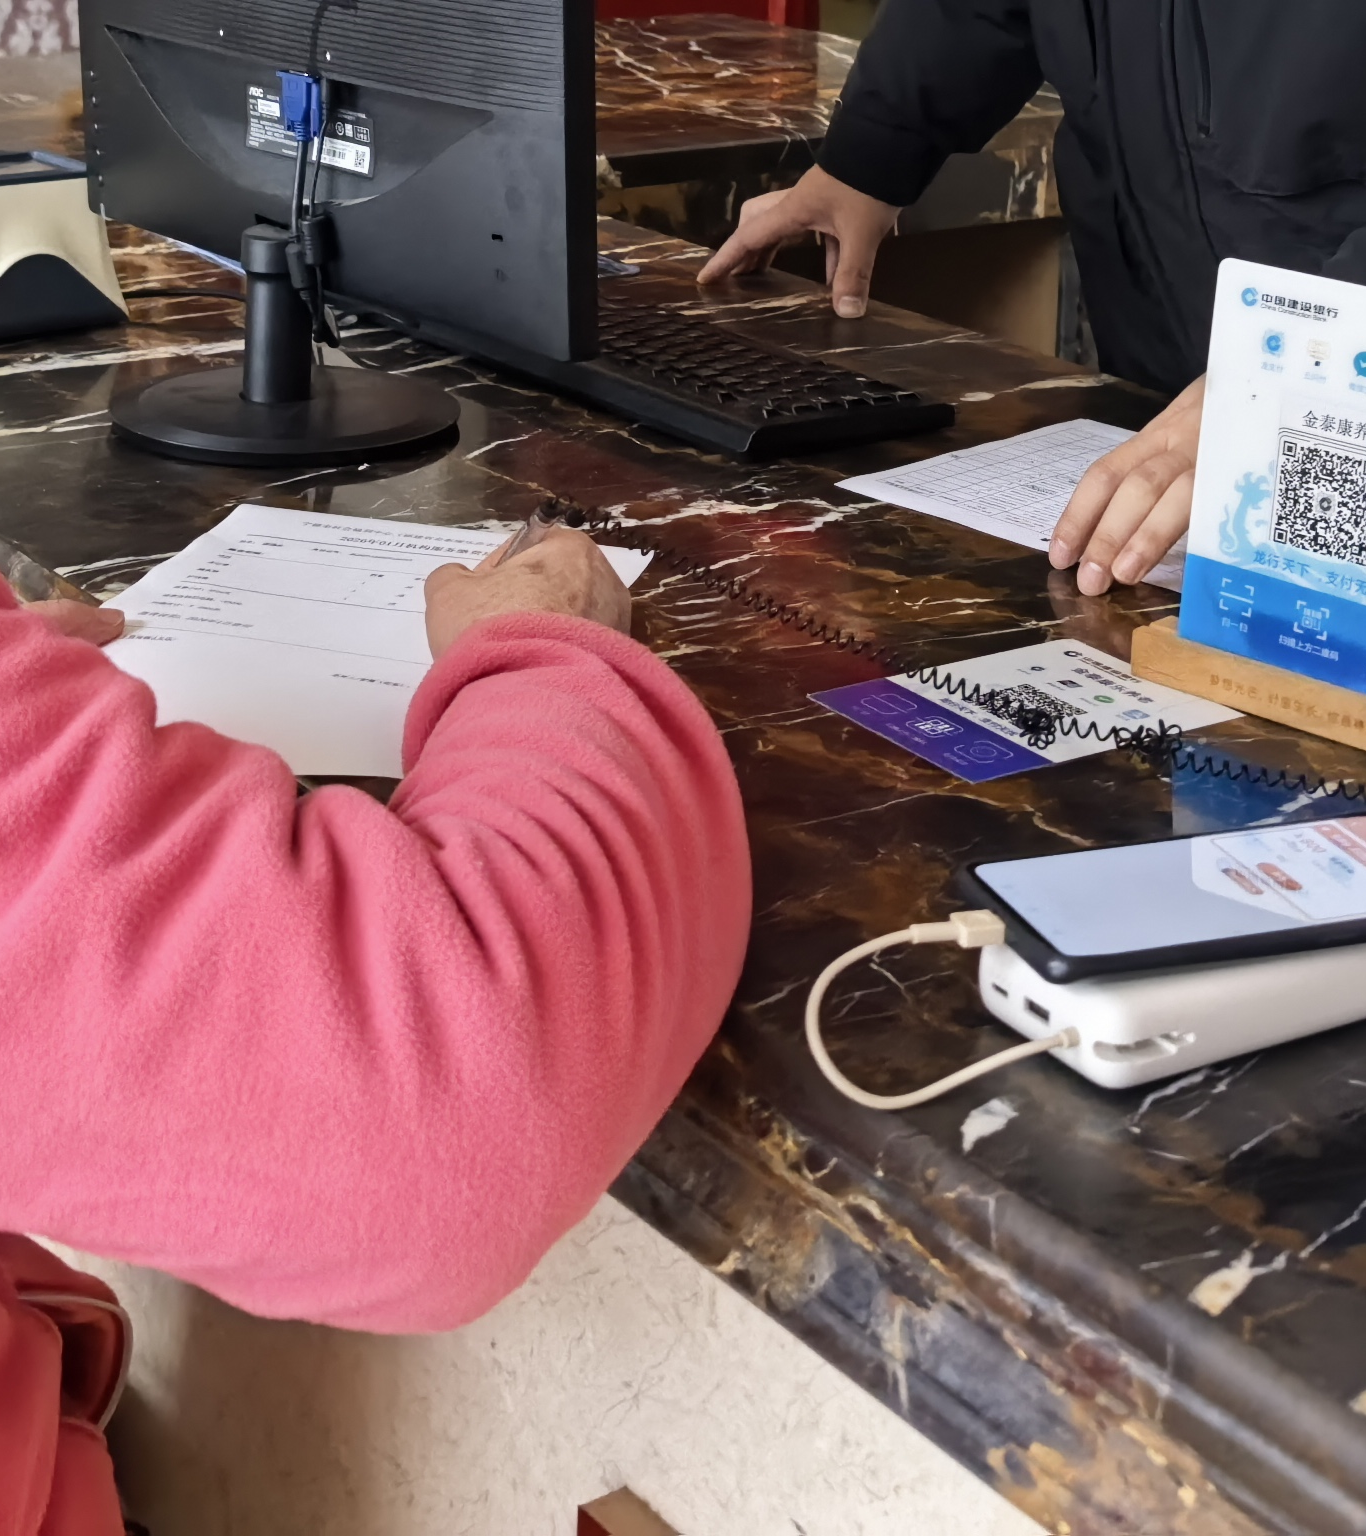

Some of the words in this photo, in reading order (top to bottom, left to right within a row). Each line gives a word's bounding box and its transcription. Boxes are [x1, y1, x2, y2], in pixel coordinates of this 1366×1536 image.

[248, 86, 264, 98] AOC
[1261, 293, 1339, 319] 中国建设银行
